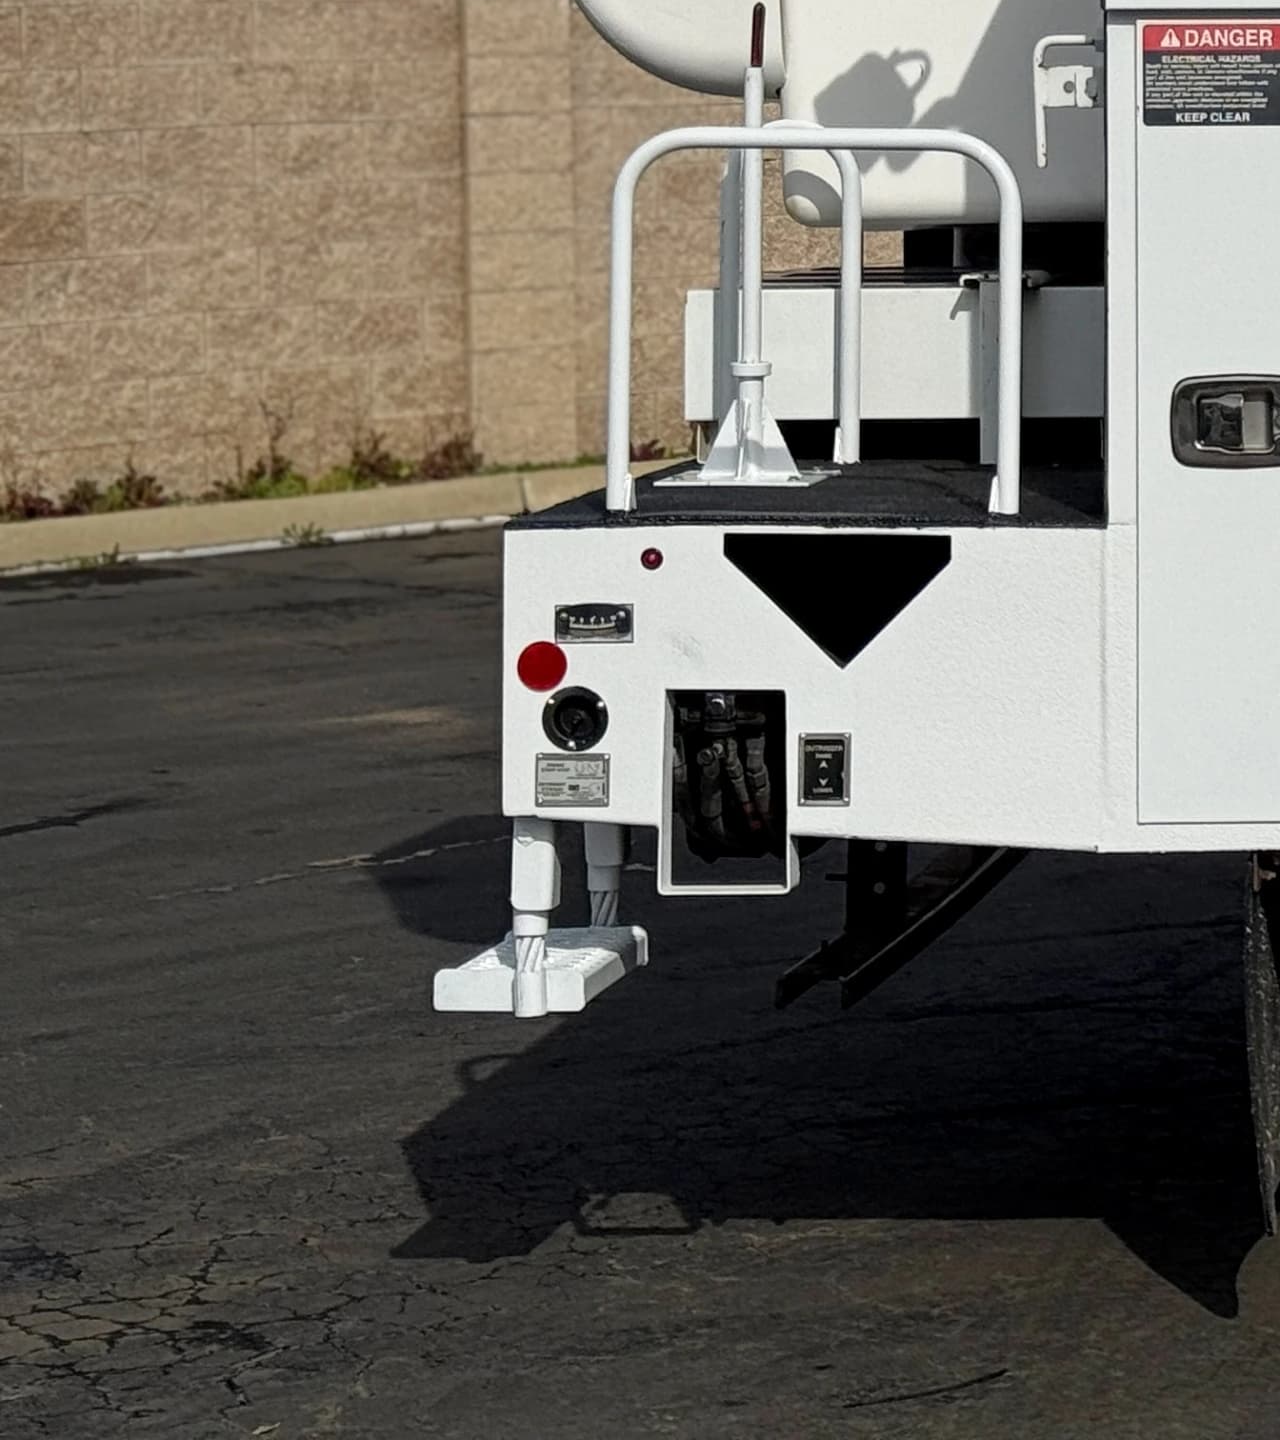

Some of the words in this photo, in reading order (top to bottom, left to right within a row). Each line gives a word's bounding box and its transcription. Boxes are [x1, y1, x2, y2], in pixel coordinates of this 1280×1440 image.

[1184, 29, 1273, 47] DANGER
[1161, 55, 1216, 63] ELECTRICAL
[1219, 55, 1261, 63] HAZARDS
[1176, 112, 1208, 123] KEEP
[1210, 112, 1250, 122] CLEAR
